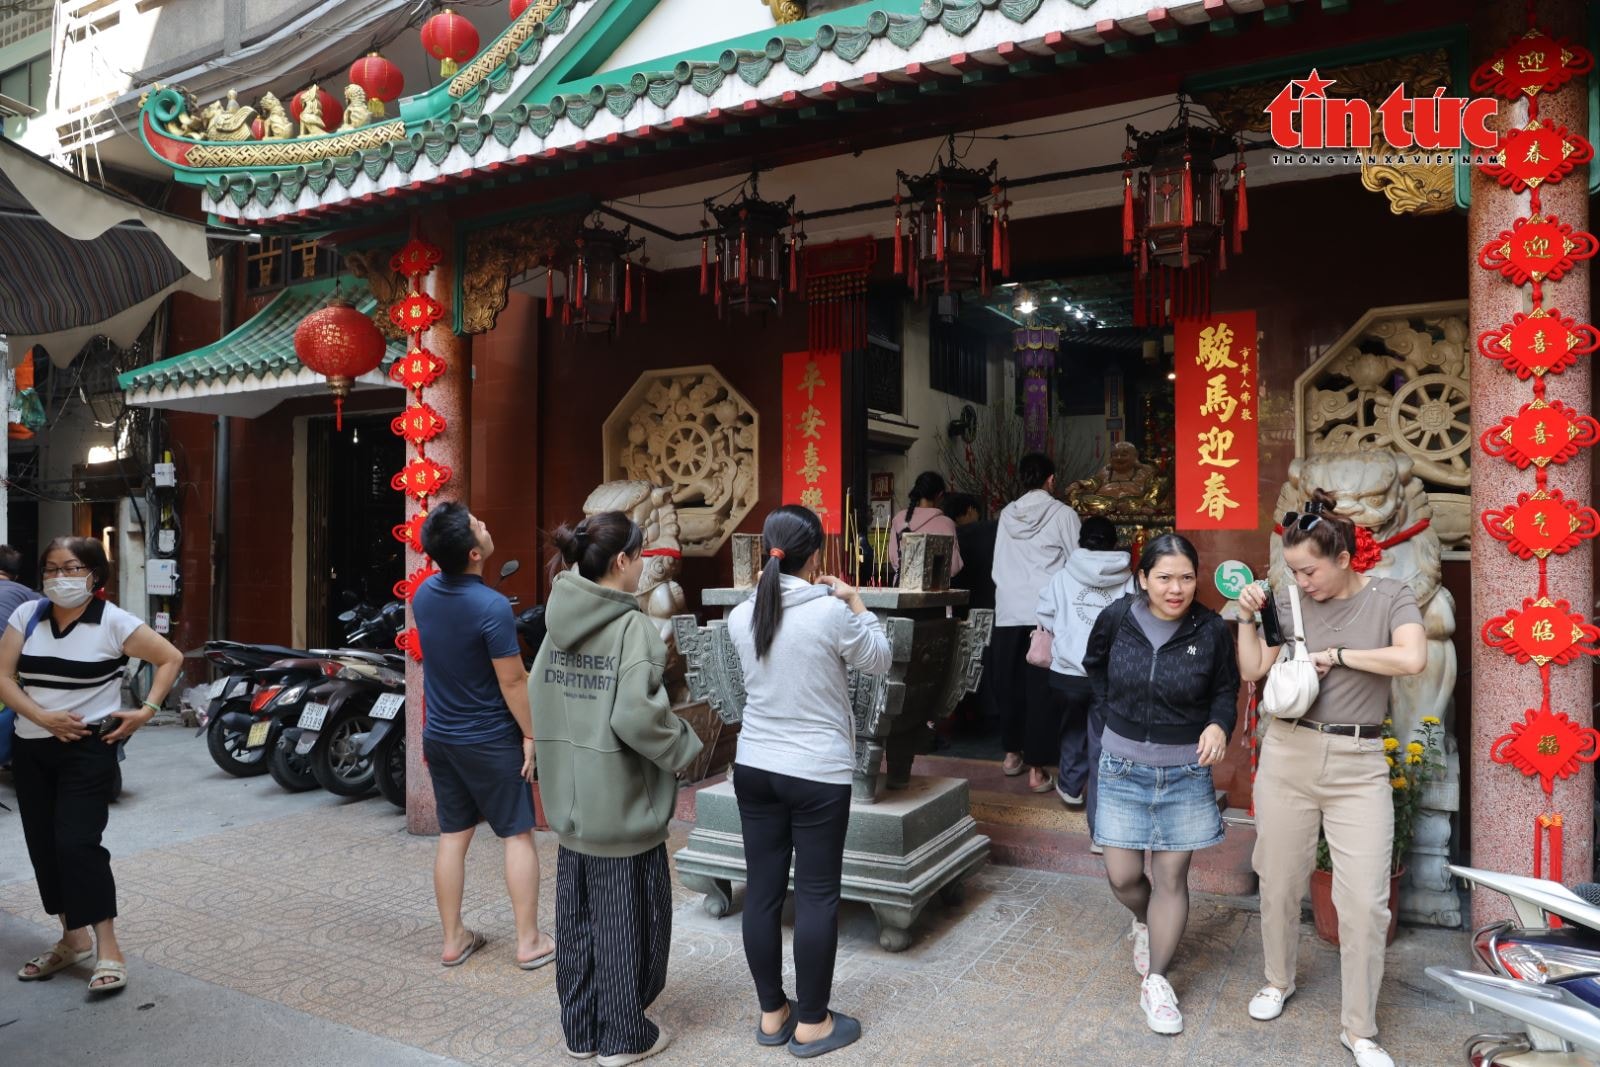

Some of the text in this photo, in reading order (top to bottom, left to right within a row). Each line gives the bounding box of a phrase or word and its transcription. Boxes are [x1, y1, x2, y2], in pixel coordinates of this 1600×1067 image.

[1523, 141, 1550, 164] 春
[1523, 235, 1553, 259] 迎
[1528, 330, 1553, 354] 喜
[1195, 322, 1240, 521] 駿馬迎春
[1528, 421, 1553, 445] 喜
